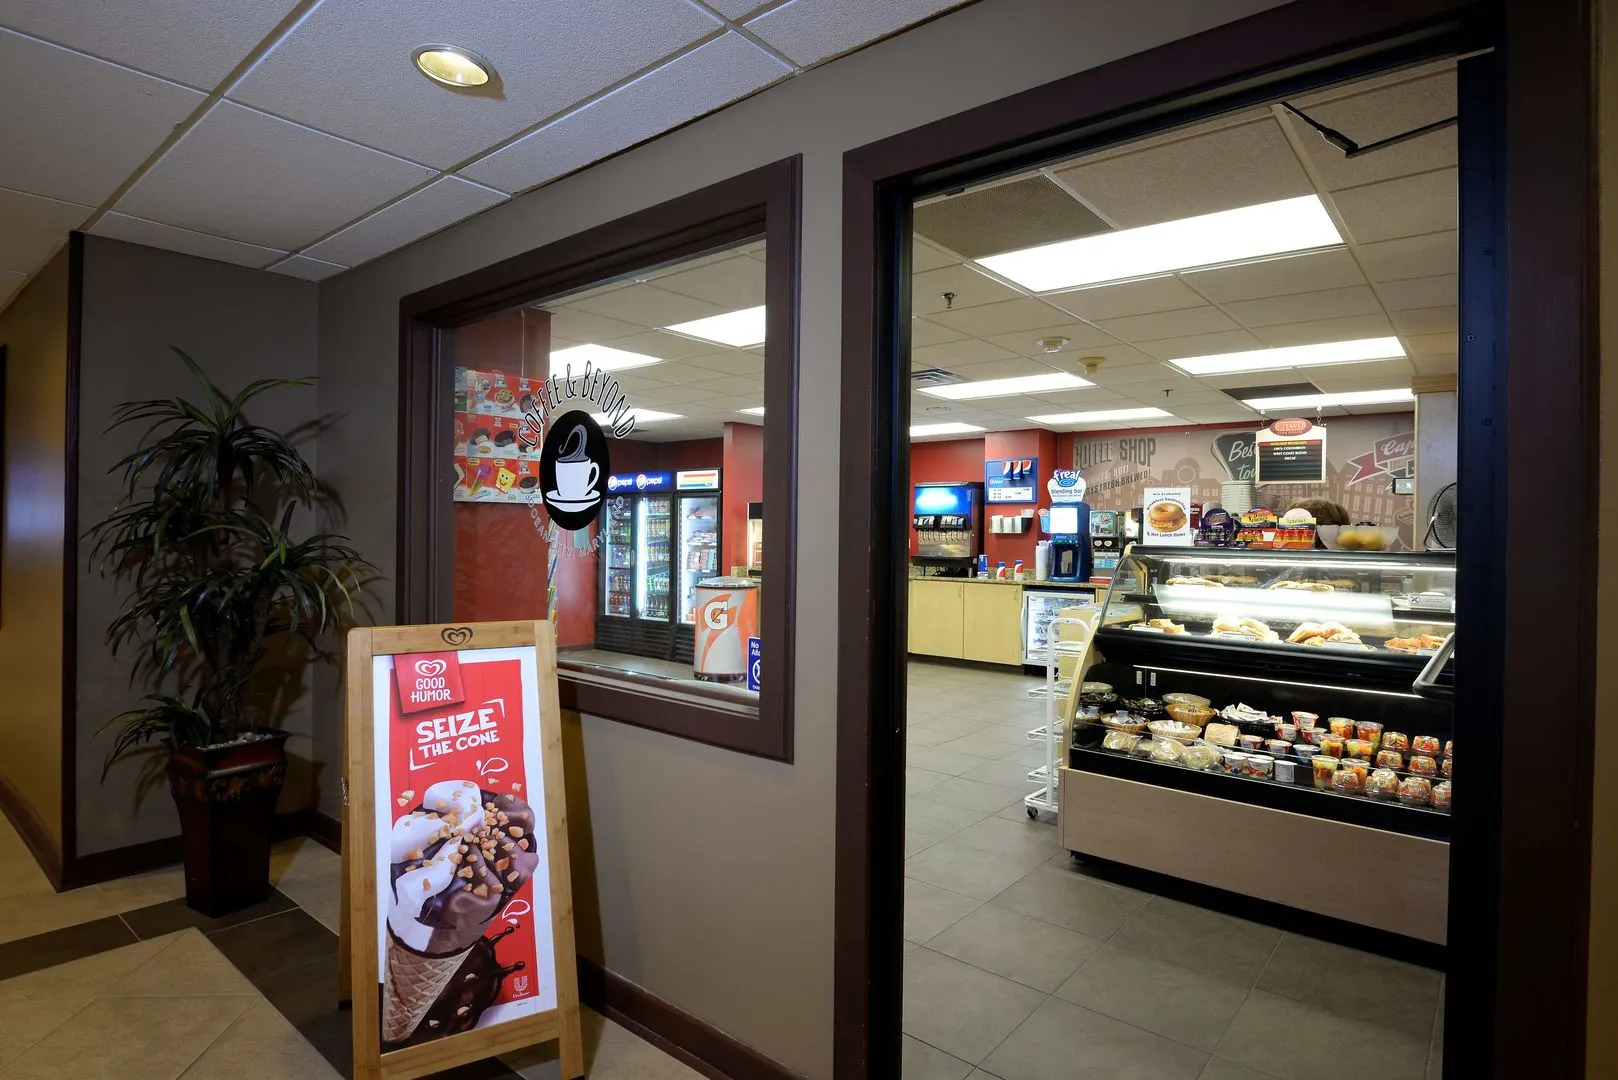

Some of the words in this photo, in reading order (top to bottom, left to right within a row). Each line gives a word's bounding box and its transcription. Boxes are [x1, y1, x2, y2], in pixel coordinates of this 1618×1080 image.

[519, 374, 563, 447] COFFEE
[565, 362, 577, 399] &
[581, 360, 636, 438] BEYOND
[1120, 437, 1156, 467] SHOP
[617, 478, 633, 488] pepsi
[646, 476, 663, 486] pepsi
[1100, 479, 1120, 491] FRESH
[1120, 469, 1151, 486] BREWED!
[527, 498, 549, 542] OCEAN
[750, 641, 760, 649] No
[410, 689, 452, 703] HUMOR
[416, 677, 446, 690] GOOD
[416, 708, 497, 743] SEIZE
[418, 741, 454, 759] THE
[455, 730, 500, 751] CONE
